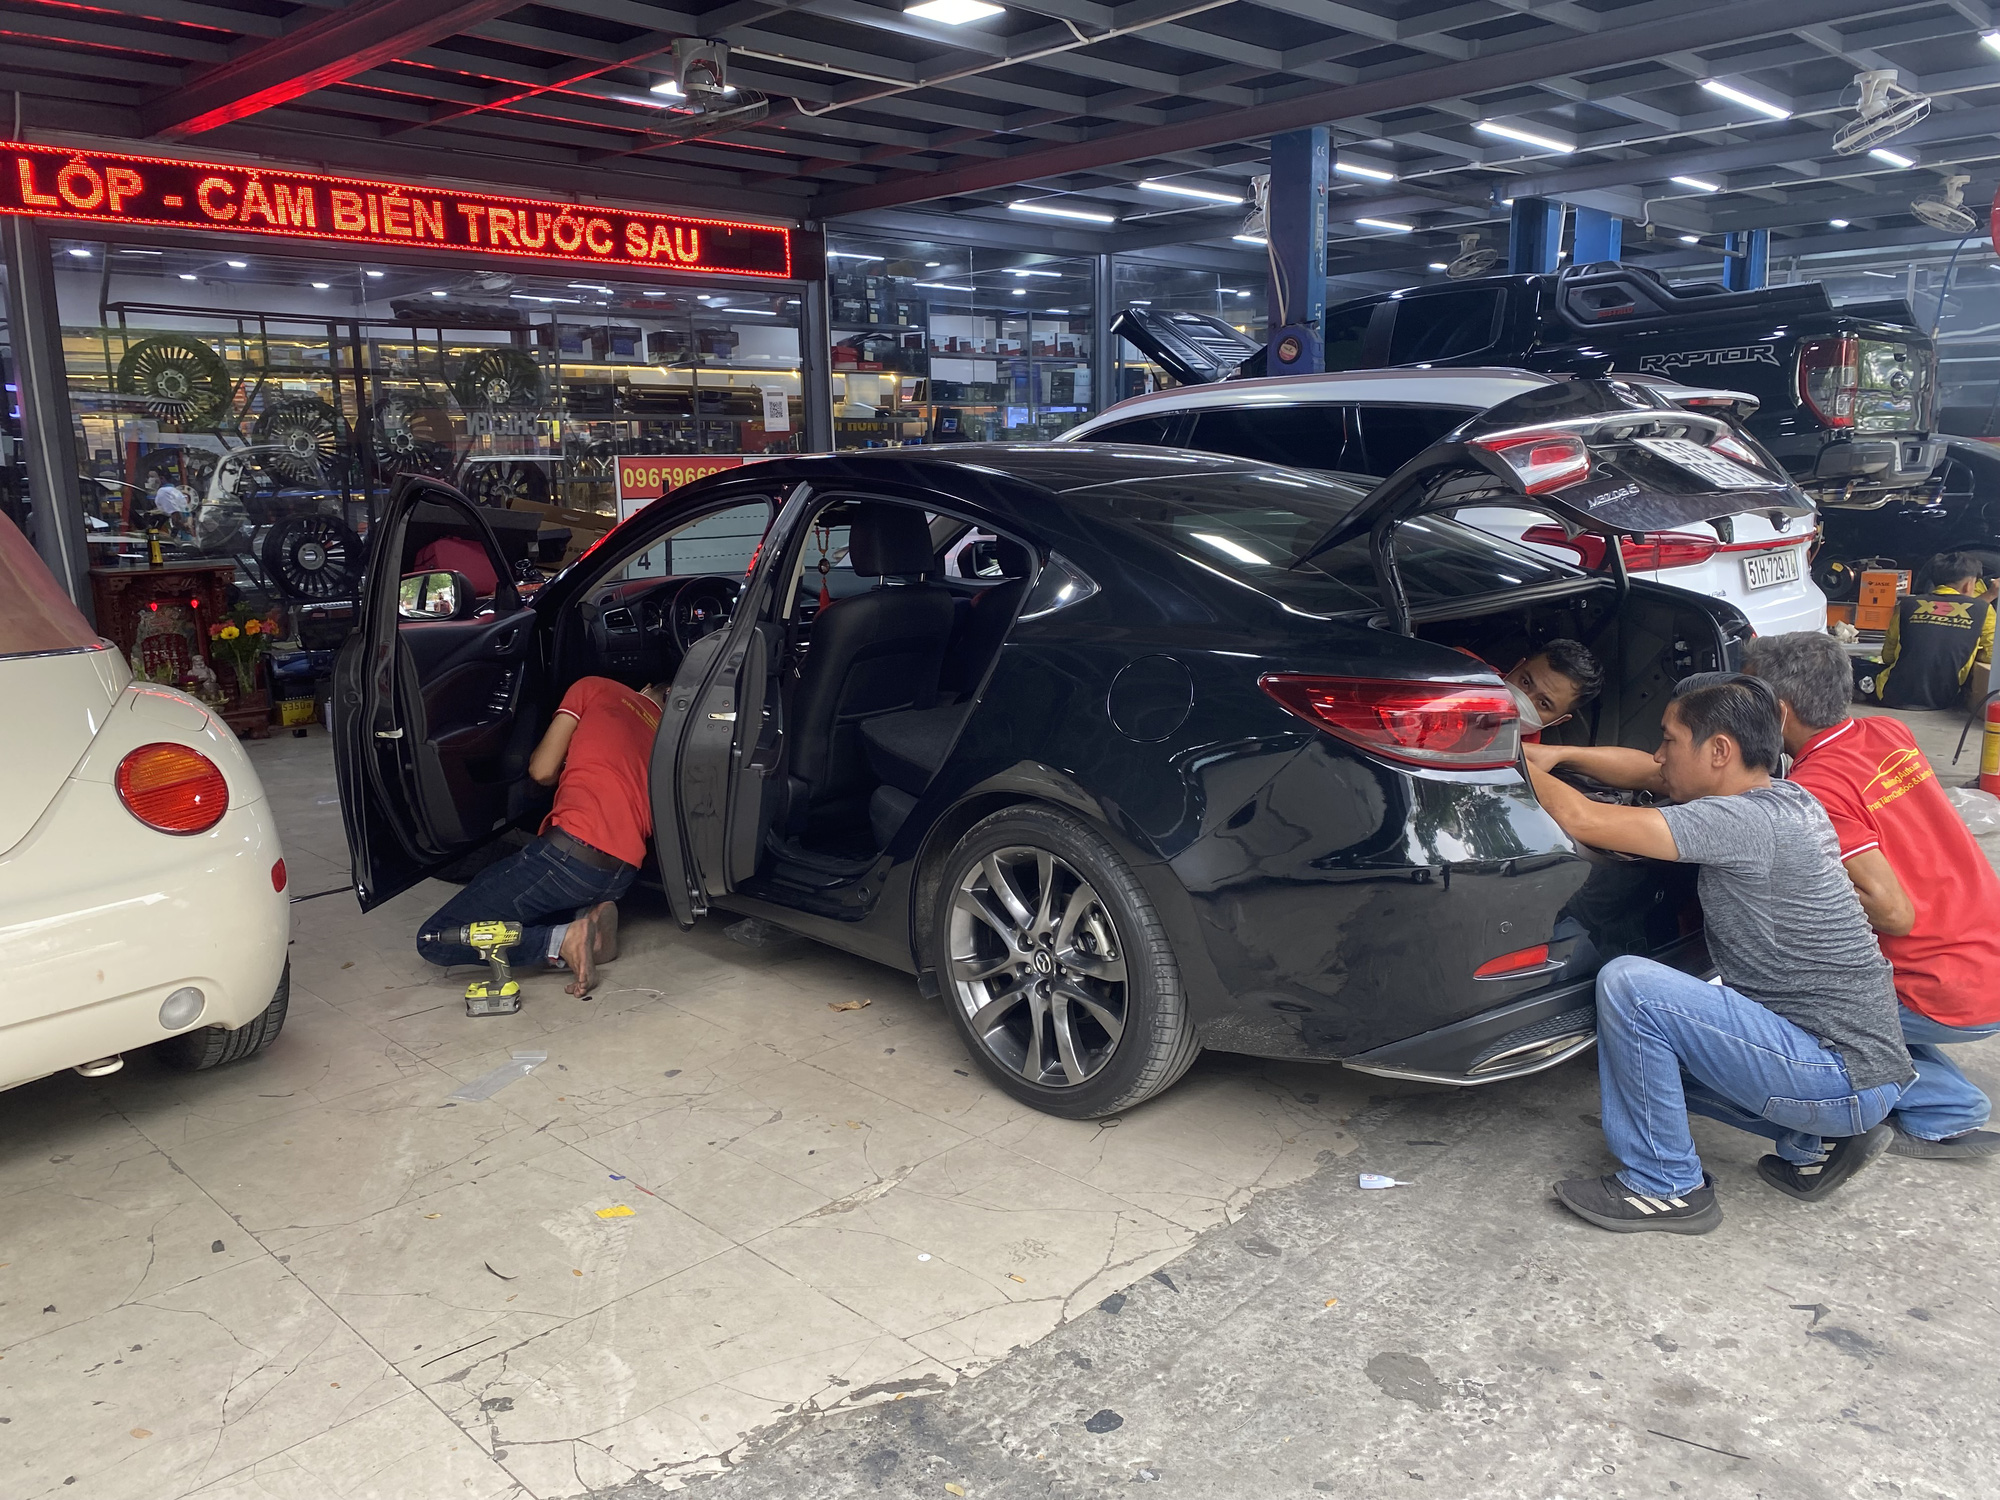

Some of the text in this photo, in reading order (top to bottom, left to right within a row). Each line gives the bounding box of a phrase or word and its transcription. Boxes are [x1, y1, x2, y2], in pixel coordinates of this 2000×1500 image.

[18, 151, 699, 262] LỐP - CẢM BIẾN TRƯỚC SAU
[1639, 344, 1781, 375] RAPTOR
